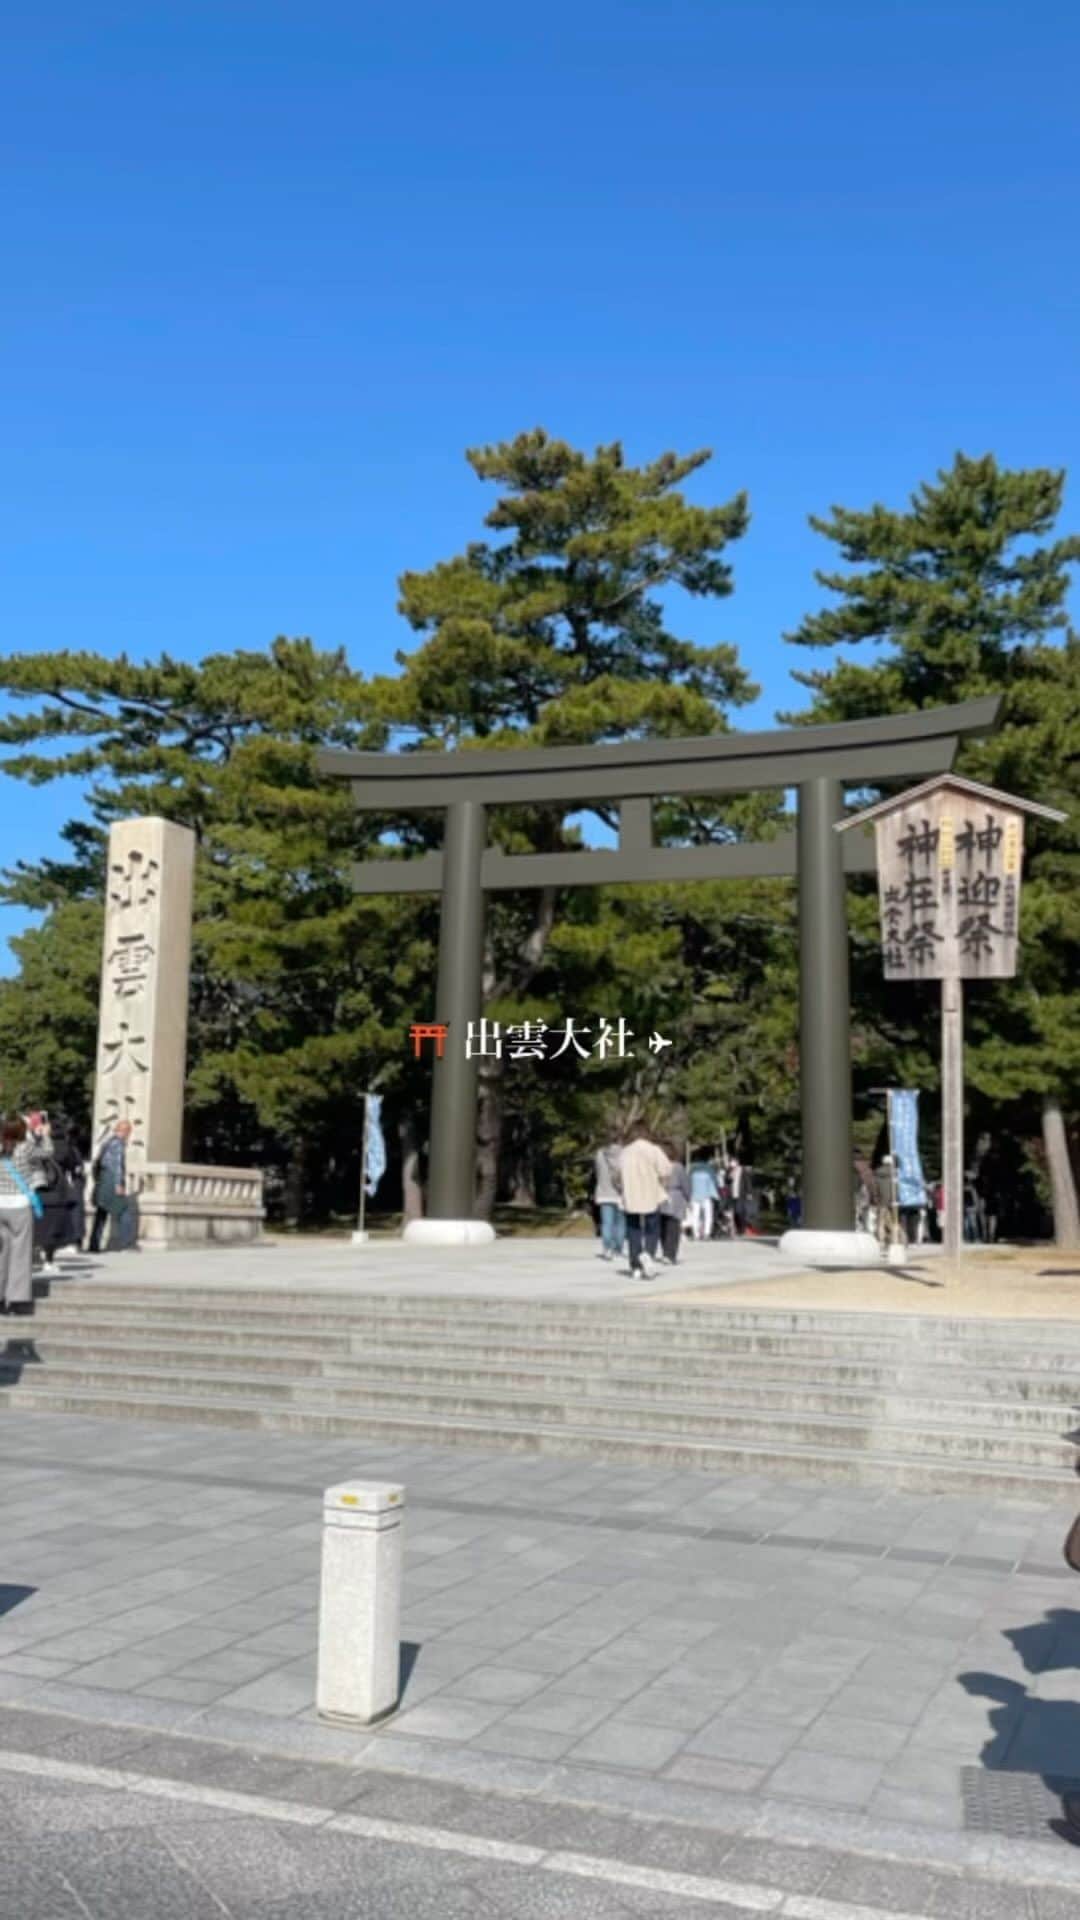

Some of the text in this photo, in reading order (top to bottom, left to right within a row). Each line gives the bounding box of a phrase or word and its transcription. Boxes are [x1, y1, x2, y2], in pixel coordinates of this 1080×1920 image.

[897, 819, 945, 966] 神在祭
[954, 814, 1005, 961] 神迎祭
